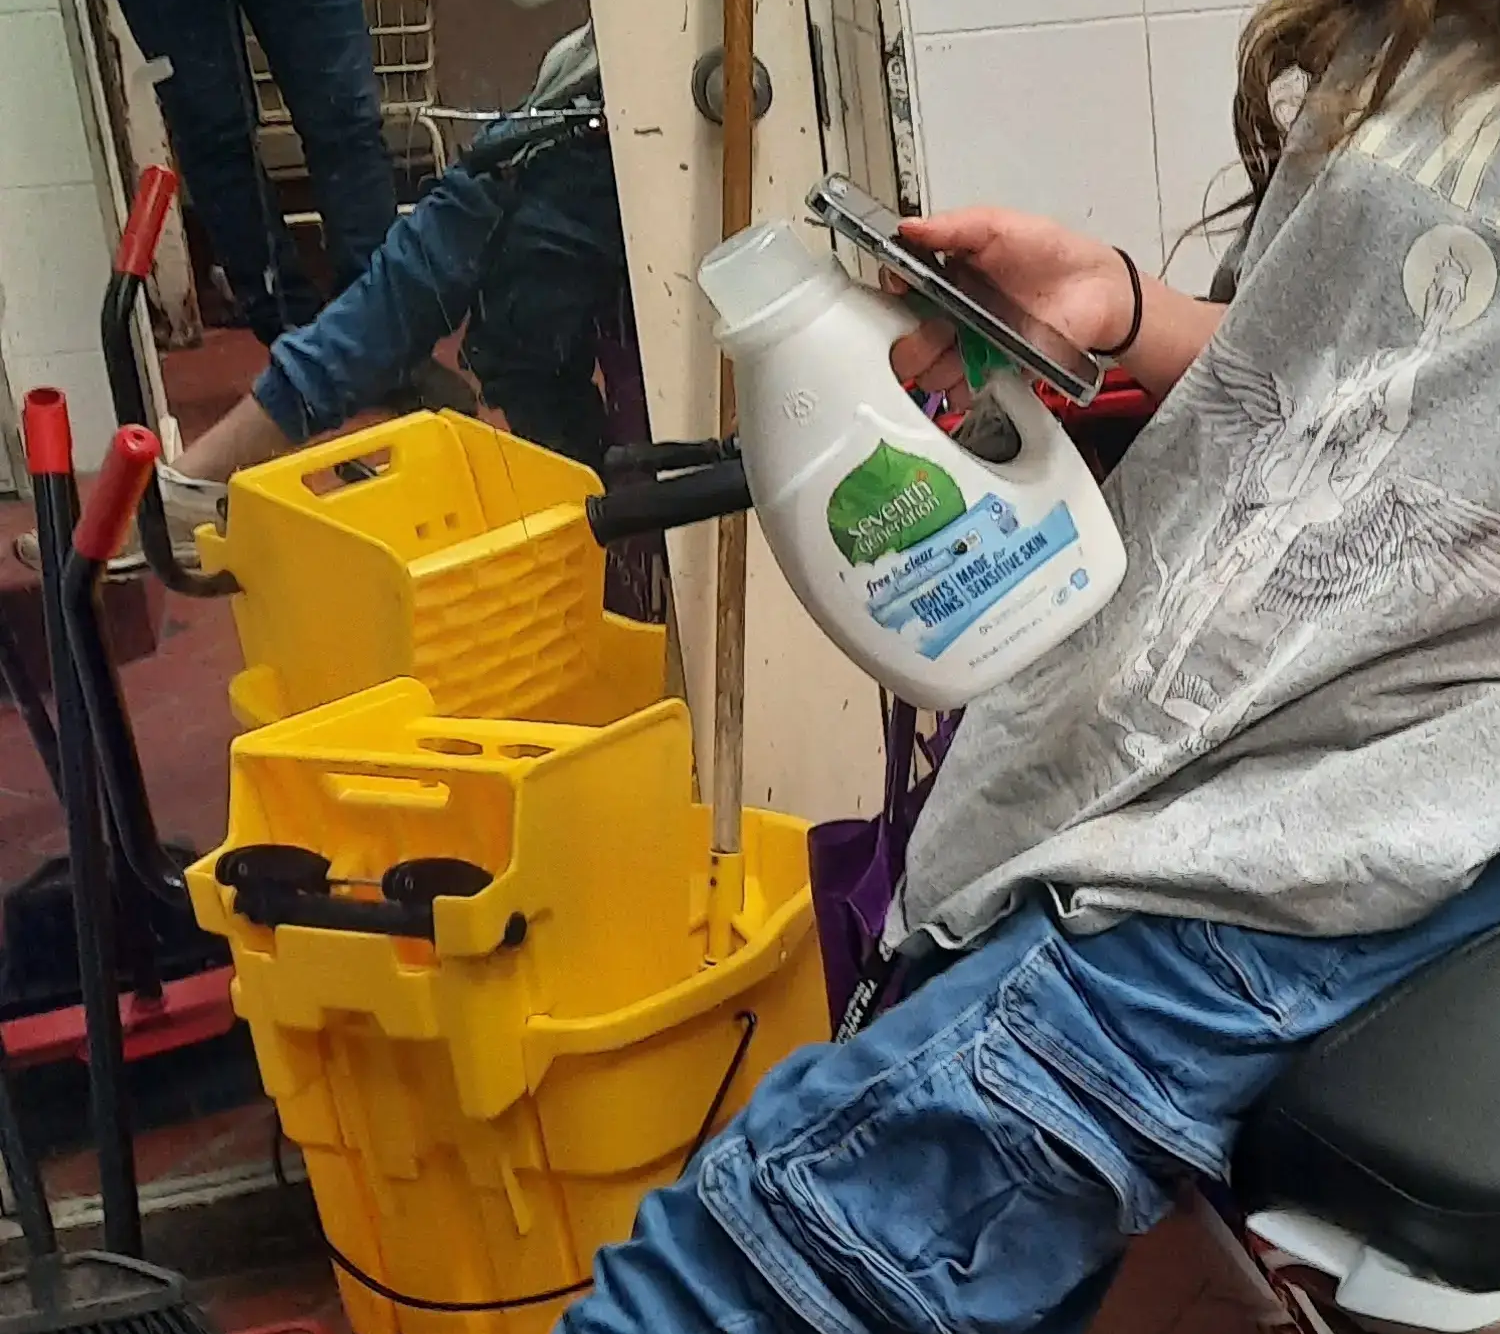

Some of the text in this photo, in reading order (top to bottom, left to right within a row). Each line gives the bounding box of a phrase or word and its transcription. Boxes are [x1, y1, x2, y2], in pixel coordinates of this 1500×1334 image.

[848, 480, 933, 539] seventh
[955, 553, 992, 586] MADE
[965, 551, 1024, 599] SENSITIVE
[1019, 531, 1048, 562] SKIN
[910, 578, 954, 616] FIGHTS
[920, 593, 964, 628] STAINS
